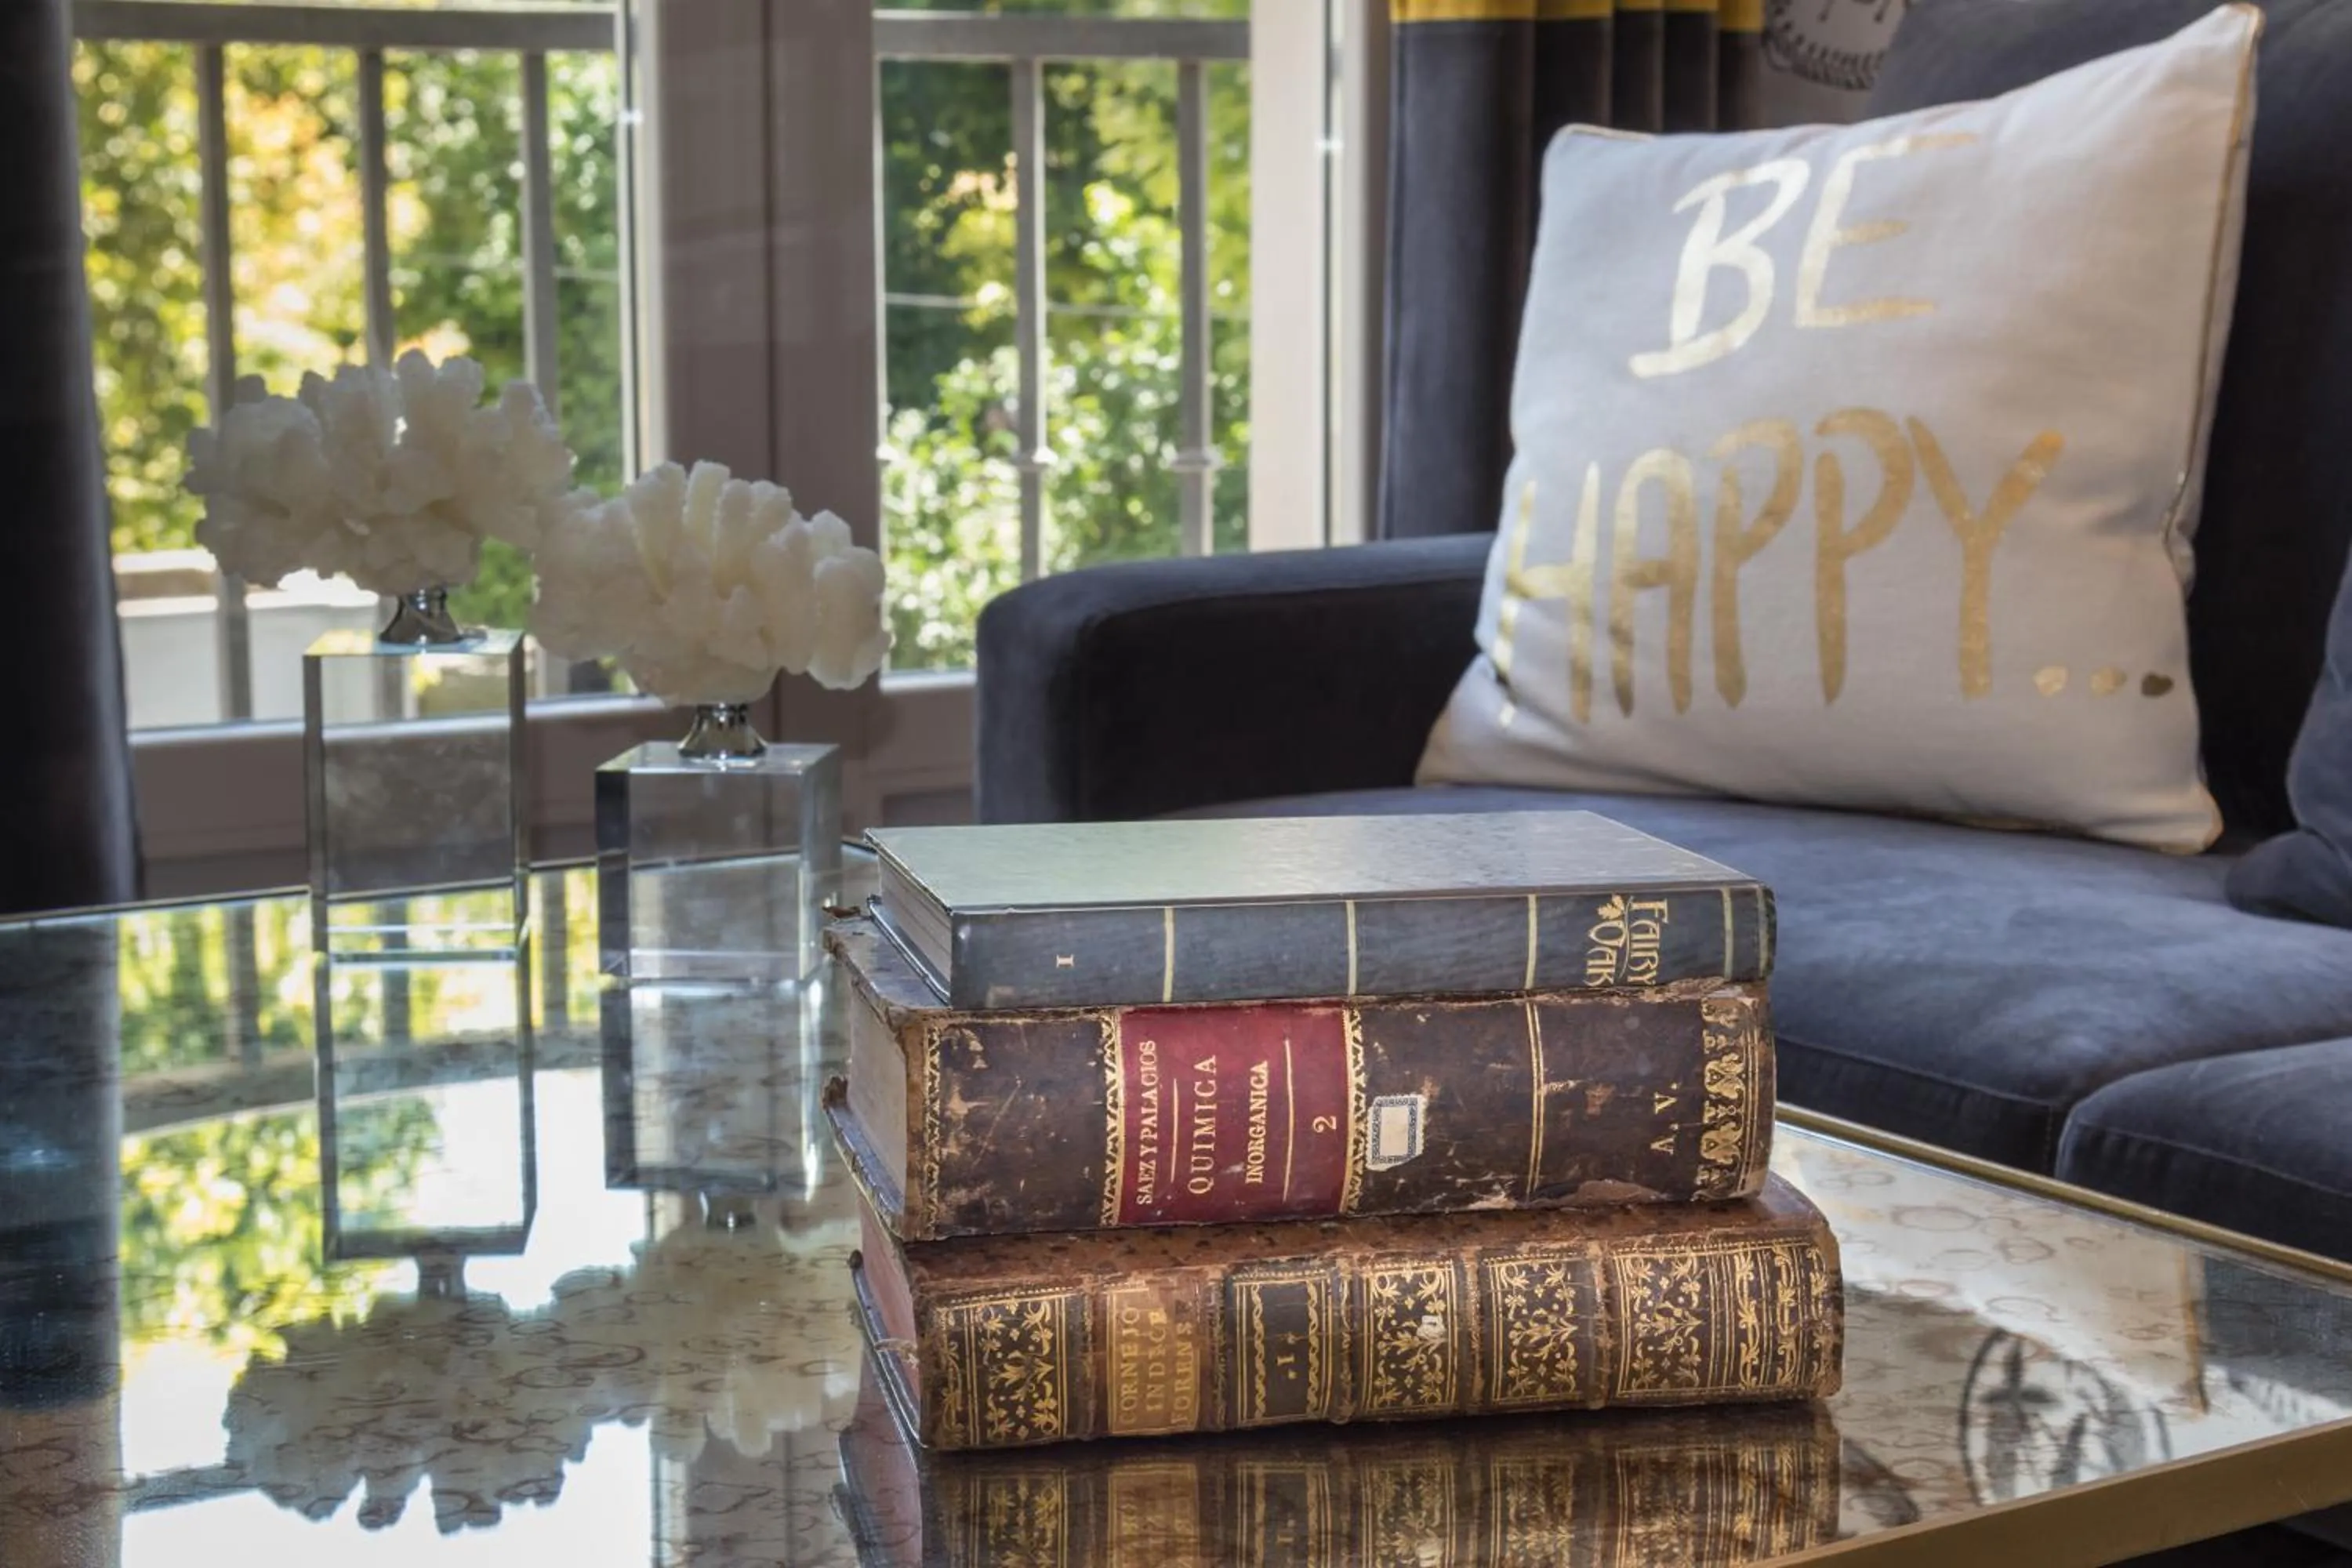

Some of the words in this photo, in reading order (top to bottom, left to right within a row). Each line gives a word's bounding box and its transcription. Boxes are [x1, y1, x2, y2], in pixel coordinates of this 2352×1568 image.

[1629, 133, 1980, 379] BE
[1582, 920, 1626, 987] OAK
[1139, 1040, 1159, 1140] PALACIOS
[1187, 1054, 1218, 1195] QUIMICA
[1244, 1060, 1269, 1184] INORGANICA
[1312, 1115, 1337, 1134] 2
[1136, 1160, 1156, 1205] SAEZ
[1140, 1143, 1158, 1157] Y
[1120, 1306, 1140, 1425] CORNEJO
